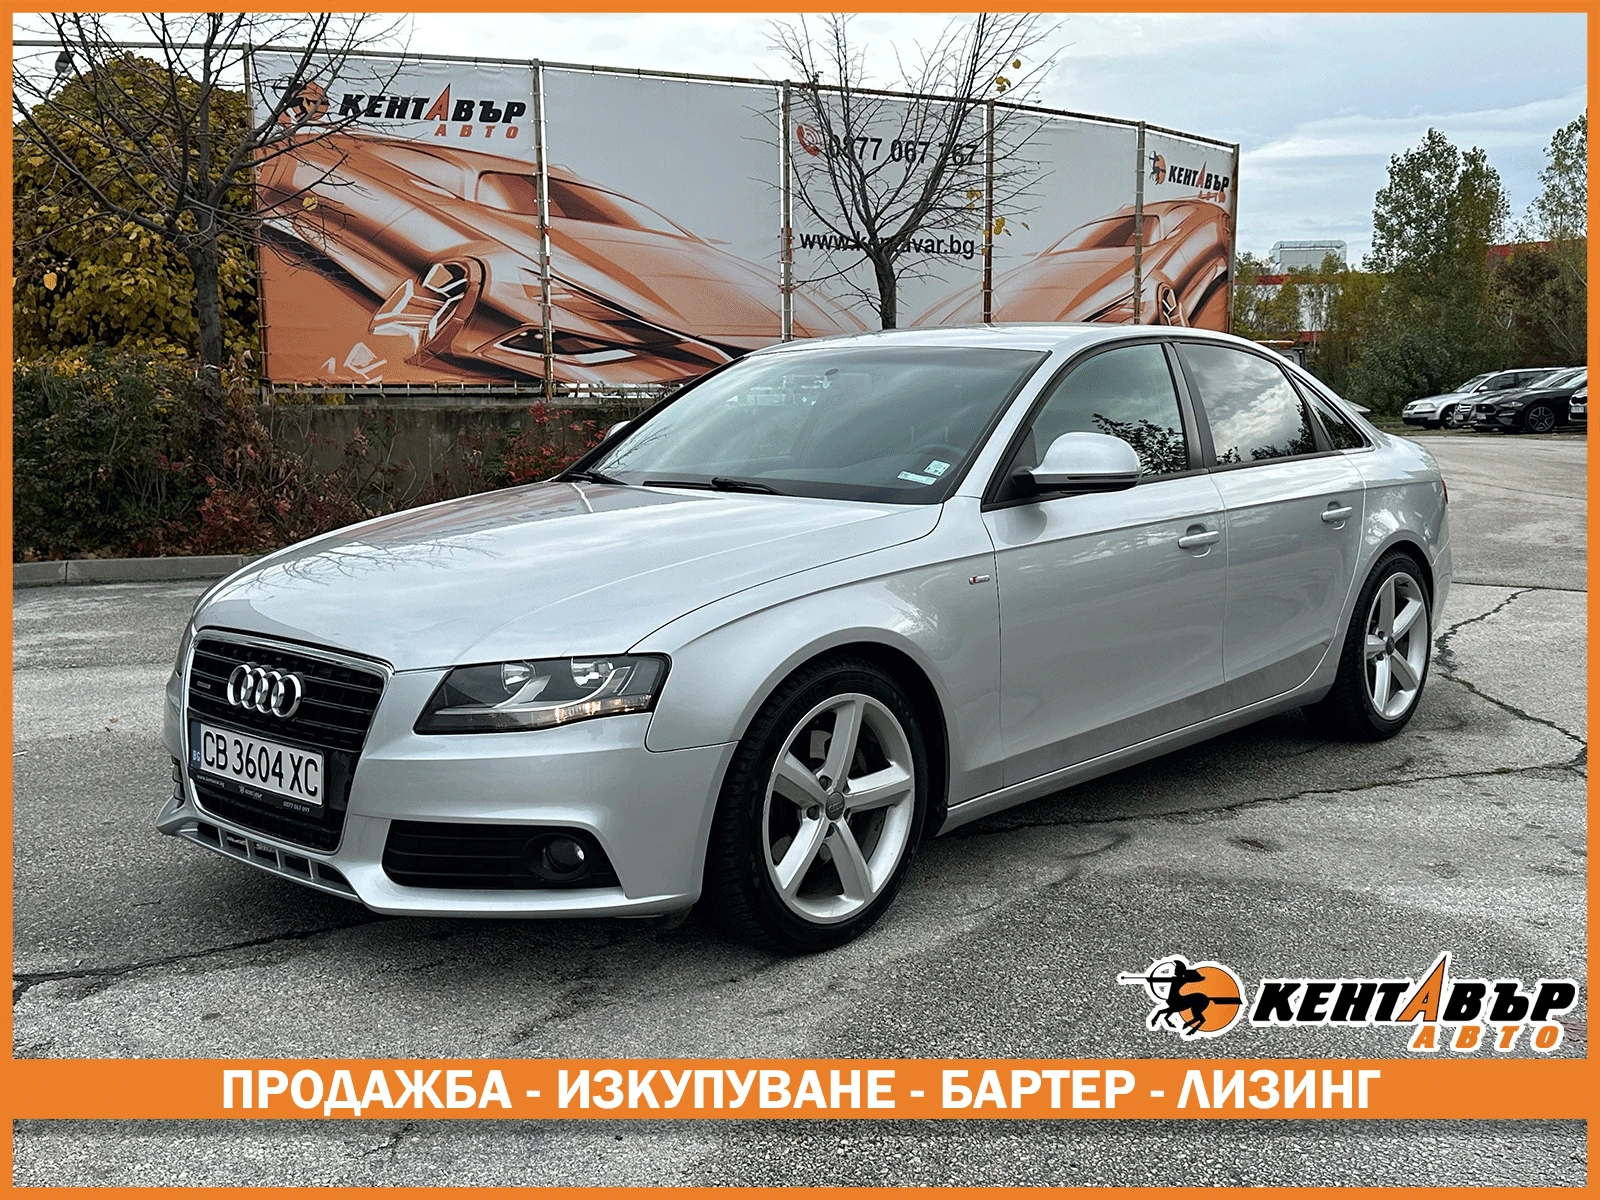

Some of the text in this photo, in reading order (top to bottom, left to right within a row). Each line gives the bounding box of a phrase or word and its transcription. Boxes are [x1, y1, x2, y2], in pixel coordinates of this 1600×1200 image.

[339, 83, 527, 124] КЕНТАВЪР
[434, 123, 519, 139] АВТО
[891, 139, 930, 163] 067
[938, 142, 978, 165] 67
[1168, 161, 1230, 192] КЕНТАВЪР
[203, 730, 318, 797] CB 3604 XC
